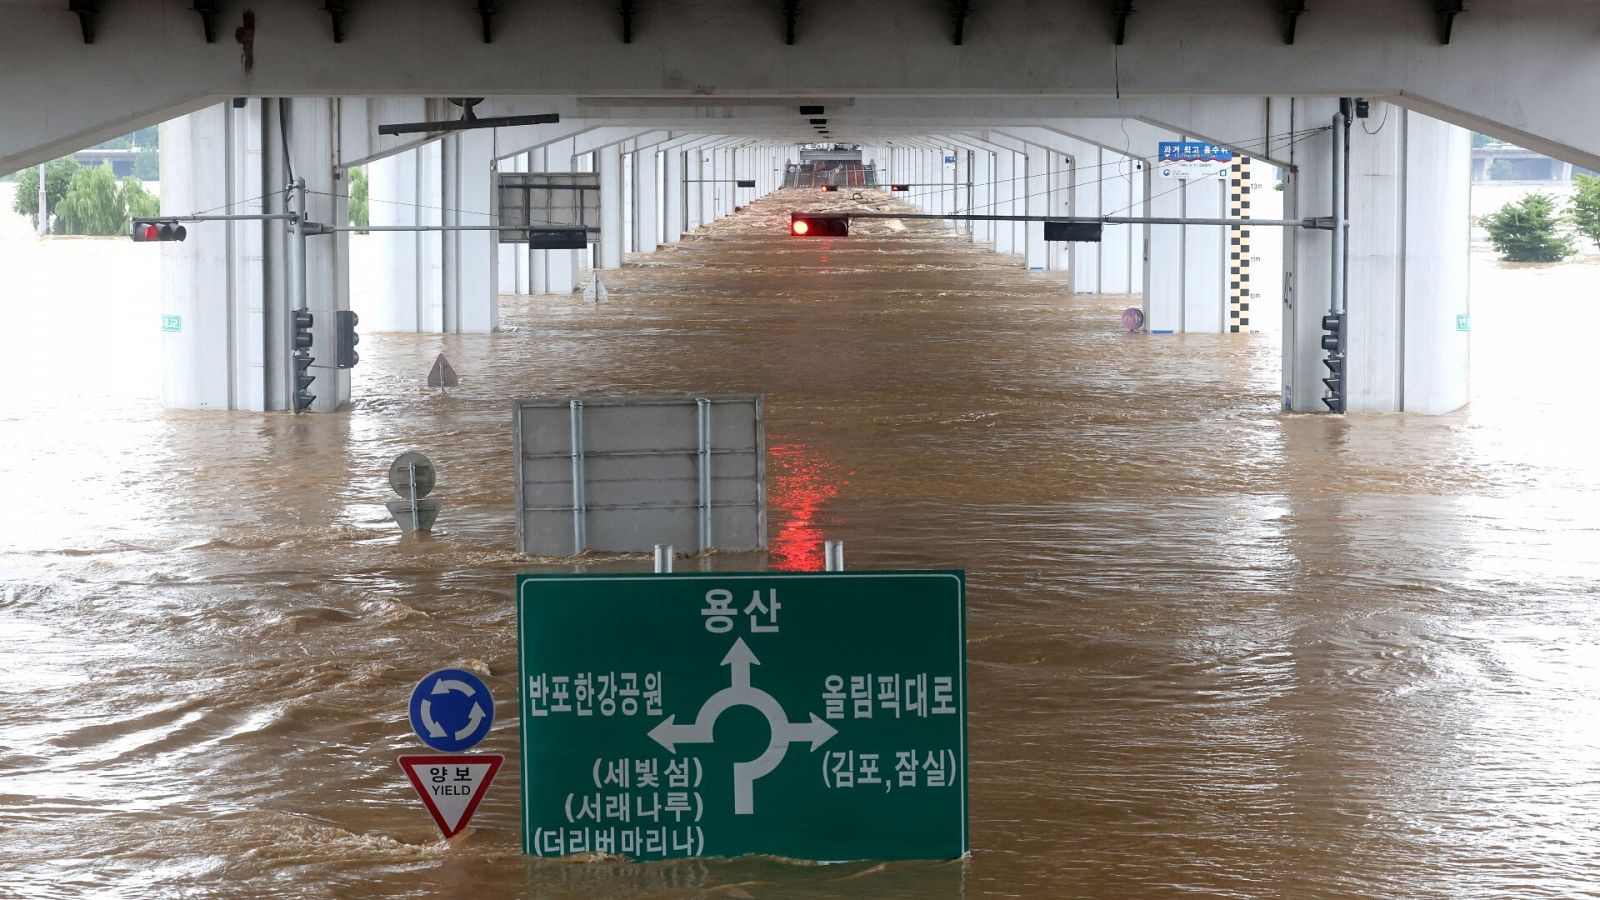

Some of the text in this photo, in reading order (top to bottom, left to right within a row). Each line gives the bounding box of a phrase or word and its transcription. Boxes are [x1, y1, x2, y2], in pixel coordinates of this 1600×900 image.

[701, 588, 782, 633] 용산
[529, 671, 663, 717] 반포한강공원
[822, 673, 957, 719] 올림픽대로
[430, 766, 472, 783] 양보
[593, 757, 703, 788] (세빛섬)
[823, 749, 957, 793] (김포,잠실)
[432, 785, 471, 796] YIELD
[565, 792, 704, 823] (서래나루)
[534, 826, 704, 857] (더리버마리나)
